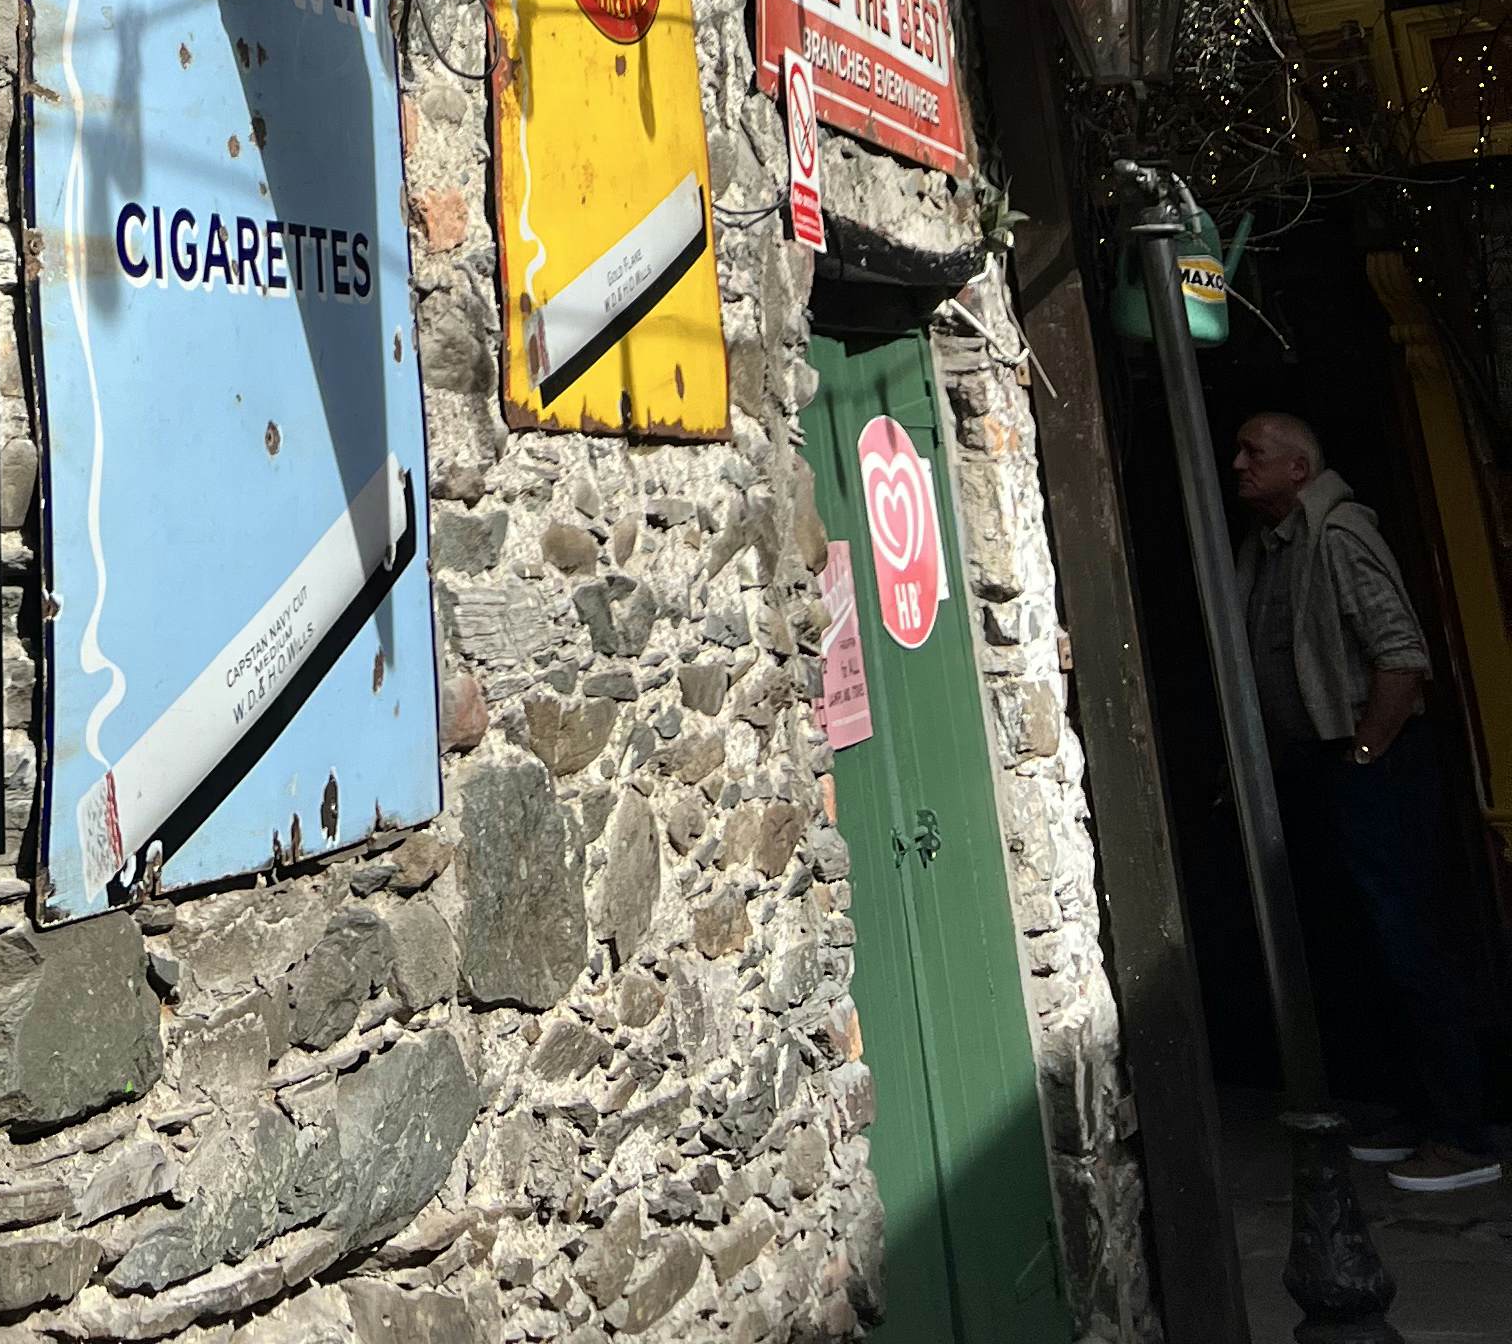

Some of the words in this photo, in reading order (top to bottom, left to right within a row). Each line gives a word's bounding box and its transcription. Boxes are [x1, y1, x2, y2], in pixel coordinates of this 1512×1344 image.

[802, 26, 872, 92] BRANCHES
[116, 201, 372, 298] CIGARETTES
[226, 633, 268, 688] CAPSTAN
[268, 605, 291, 638] NAVY
[292, 585, 309, 613] CUT
[894, 581, 922, 630] HB
[254, 625, 293, 676] MEDIUM
